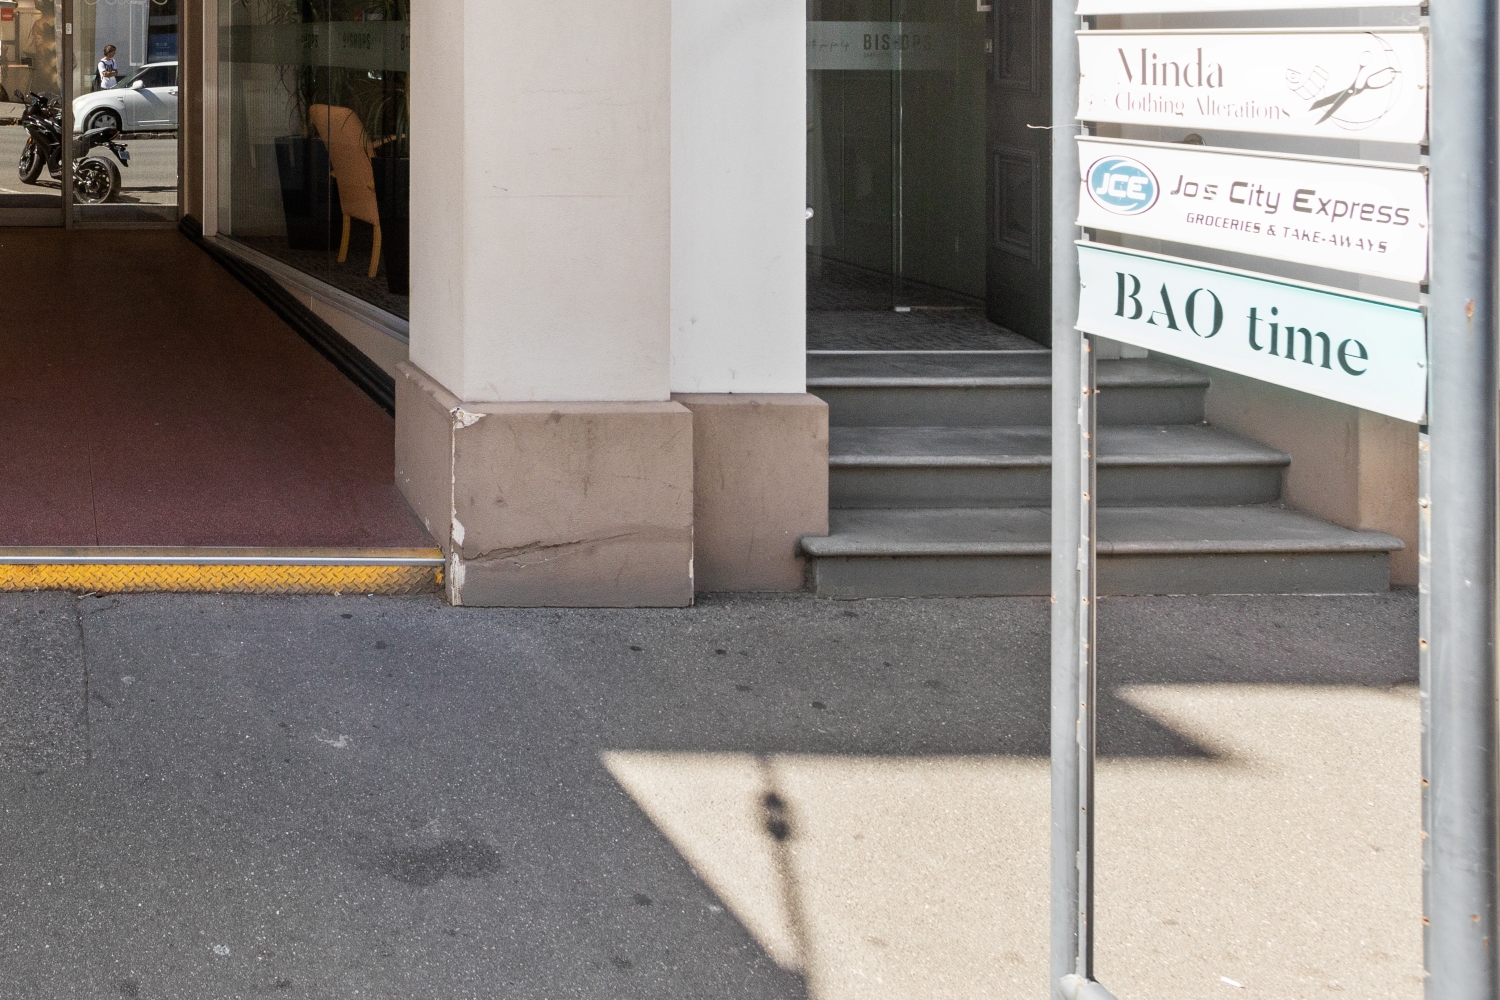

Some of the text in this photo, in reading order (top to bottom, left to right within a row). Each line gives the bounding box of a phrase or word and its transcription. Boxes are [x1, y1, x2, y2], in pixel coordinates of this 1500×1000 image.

[1117, 47, 1224, 89] Minda
[1115, 93, 1291, 121] Clothing Alterations
[1095, 173, 1150, 202] JCE
[1229, 181, 1281, 215] City
[1293, 189, 1411, 227] Express
[1186, 211, 1389, 254] GROCERIES & TAKE-AWAYS
[1113, 270, 1370, 377] BAO time
